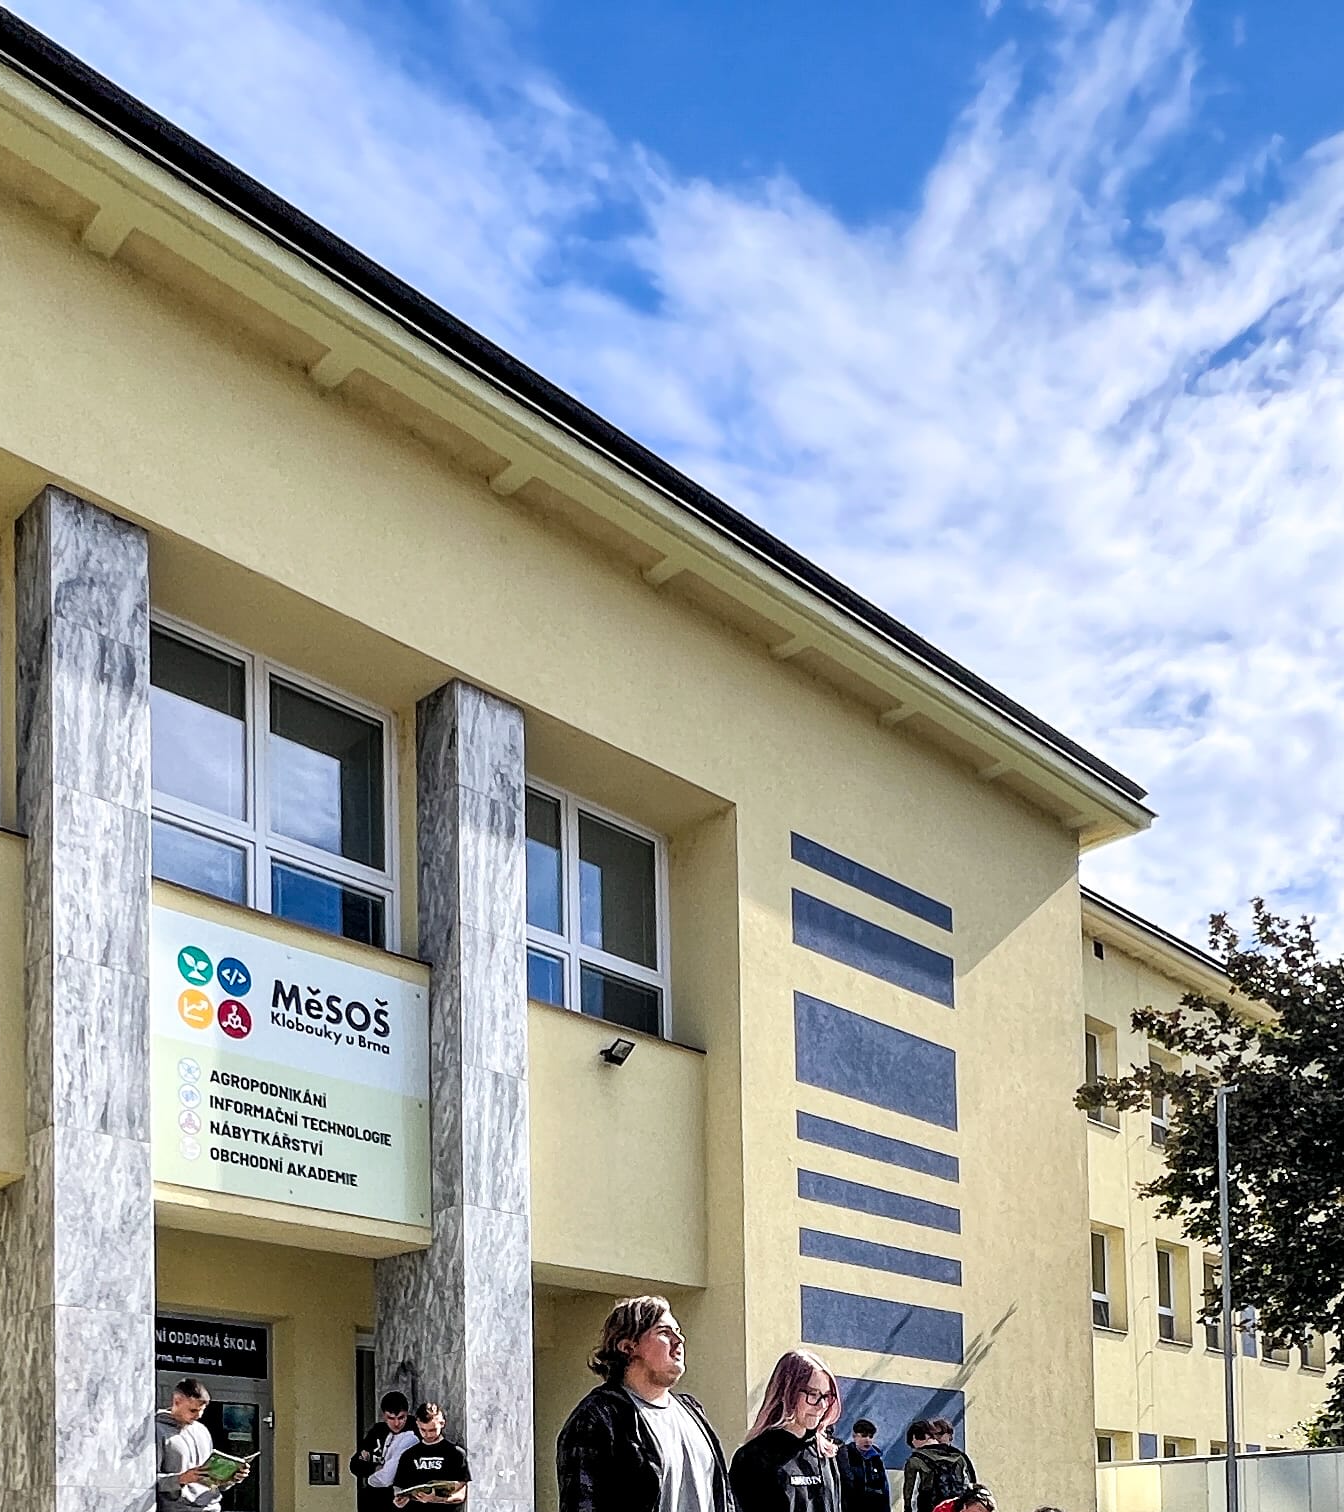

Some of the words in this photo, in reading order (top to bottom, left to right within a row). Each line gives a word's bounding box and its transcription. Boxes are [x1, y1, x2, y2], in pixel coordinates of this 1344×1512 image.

[272, 979, 390, 1038] MěSOŠ
[271, 1011, 342, 1046] Klobouky
[346, 1035, 354, 1045] u
[358, 1035, 390, 1055] Brna
[210, 1070, 327, 1109] AGROPODNIKÁNÍ
[210, 1095, 298, 1127] INFORMAČNÍ
[301, 1115, 392, 1147] TECHNOLOGIE
[210, 1120, 323, 1156] NÁBYTKÁŘSTVÍ
[210, 1147, 283, 1173] OBCHODNÍ
[287, 1162, 358, 1187] AKADEMIE
[168, 1331, 221, 1349] ODBORNÁ
[223, 1333, 257, 1351] ŠKOLA
[414, 1457, 444, 1470] VANS
